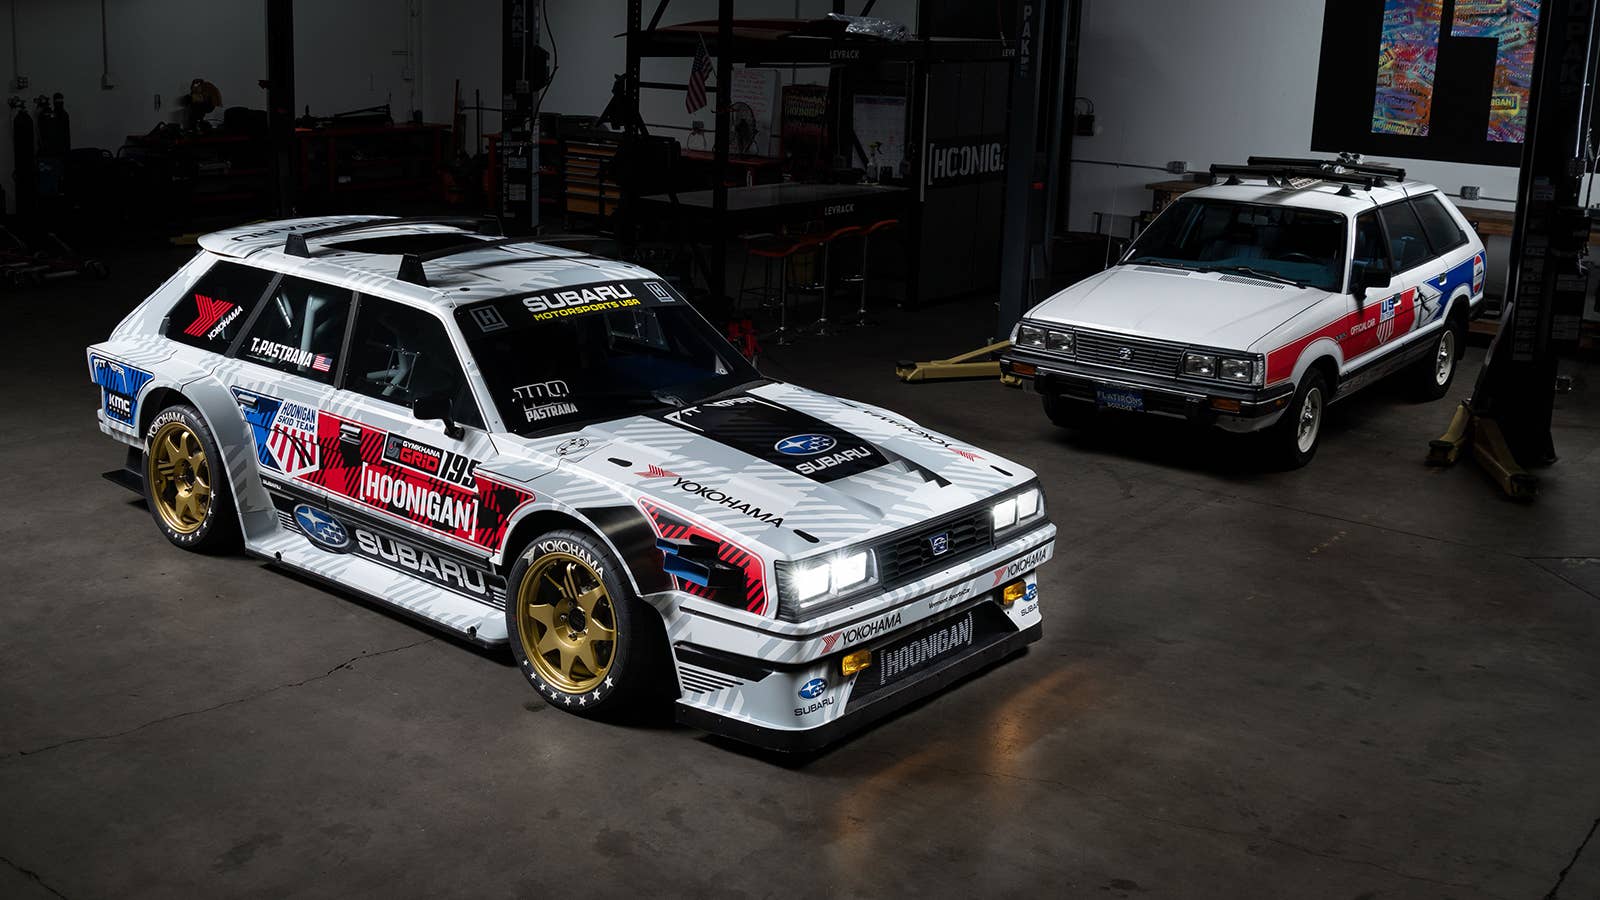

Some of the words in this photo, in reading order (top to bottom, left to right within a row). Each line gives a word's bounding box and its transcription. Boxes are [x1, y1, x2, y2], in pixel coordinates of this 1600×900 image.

[207, 305, 244, 341] YOKOHAMA
[533, 302, 619, 321] MOTORSPORTS
[620, 298, 641, 308] USA
[148, 411, 186, 438] YOKOHAMA
[277, 416, 295, 427] SKID
[296, 420, 315, 433] TEAM
[280, 401, 316, 424] HOONIGAN
[525, 402, 579, 422] PASTRANA
[402, 440, 441, 459] GYMKHANA
[795, 446, 872, 475] SUBARU
[360, 461, 479, 541] [HOONIGAN]
[673, 477, 784, 528] YOKOHAMA
[538, 540, 604, 579] YOKOHAMA
[1006, 551, 1047, 578] YOKOHAMA
[842, 612, 902, 647] YOKOHAMA
[880, 612, 972, 686] [HOONIGAN]
[794, 696, 835, 717] SUBARU
